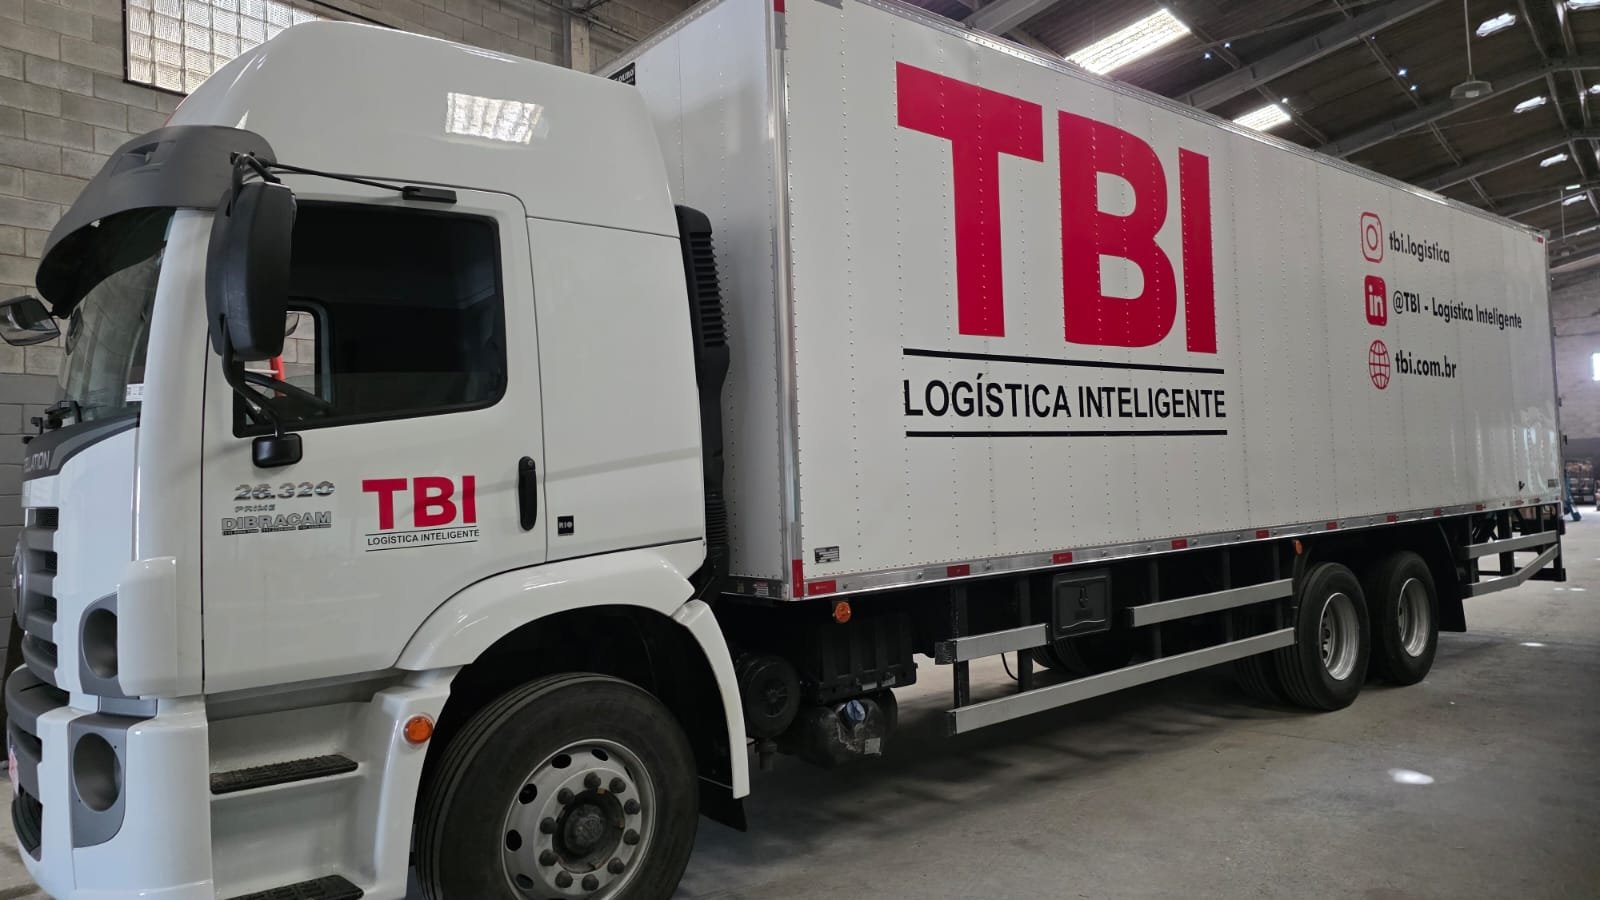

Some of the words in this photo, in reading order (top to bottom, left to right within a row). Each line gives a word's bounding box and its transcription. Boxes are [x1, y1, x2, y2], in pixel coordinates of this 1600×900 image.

[896, 61, 1217, 354] TBI
[1389, 230, 1450, 263] tbi.logistica
[1392, 290, 1421, 314] @TBI
[1475, 304, 1522, 330] Inteligente
[1395, 350, 1457, 378] tbi.com.br
[903, 373, 1072, 418] LOGÍSTICA
[1078, 385, 1226, 418] INTELIGENTE
[234, 504, 276, 513] PRIME
[362, 475, 477, 531] TBI
[221, 511, 332, 531] DIBRACAM
[367, 534, 419, 546] LOGÍSTICA
[420, 529, 480, 542] INTELIGENTE
